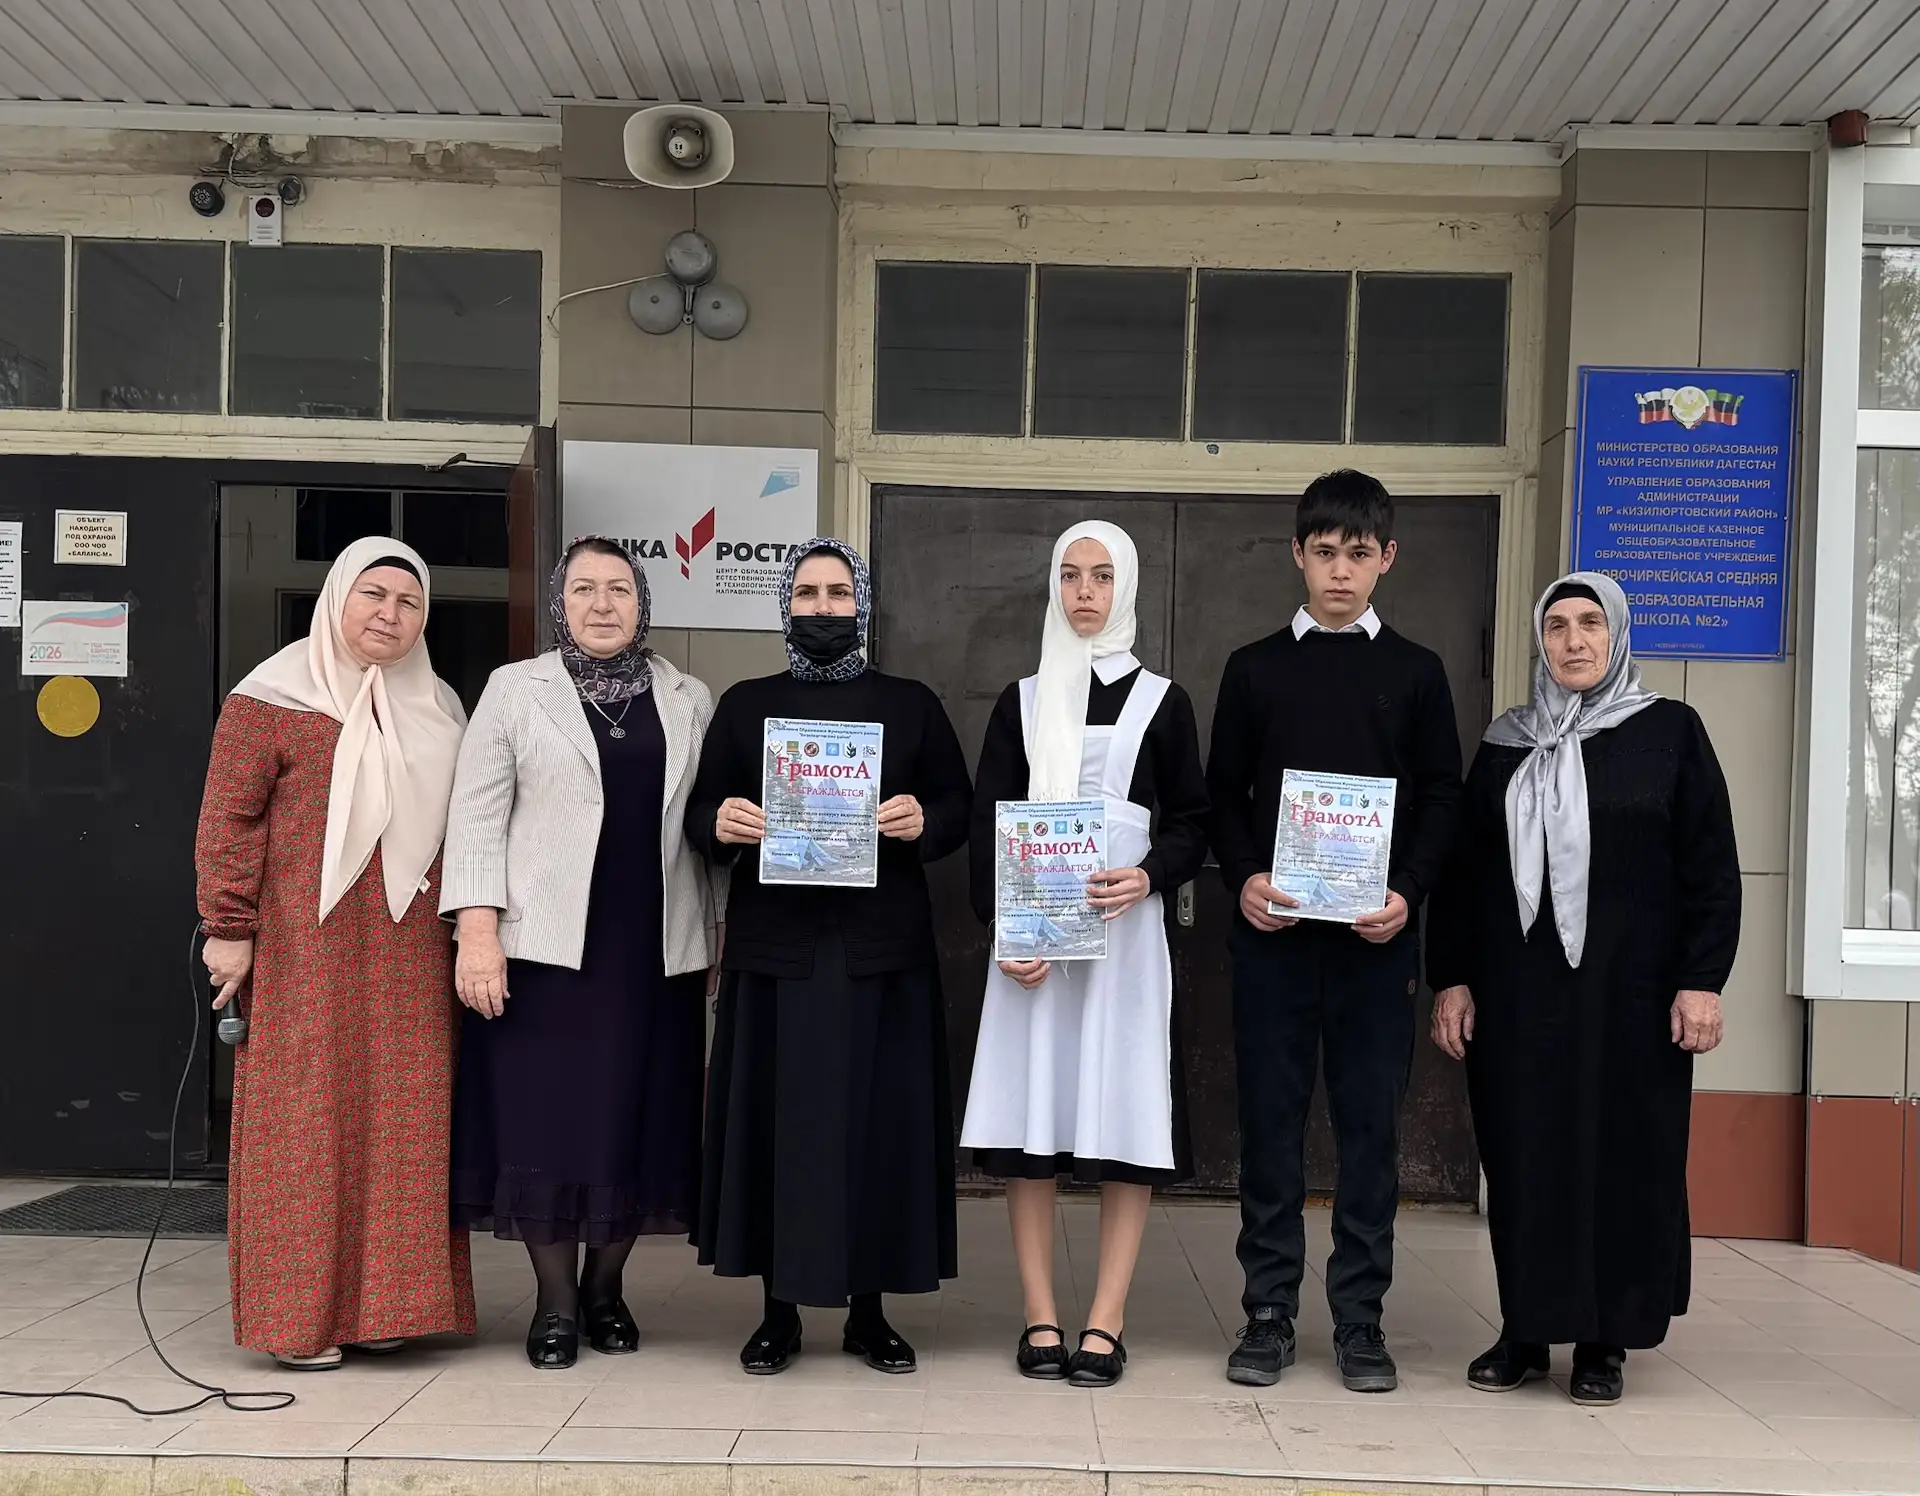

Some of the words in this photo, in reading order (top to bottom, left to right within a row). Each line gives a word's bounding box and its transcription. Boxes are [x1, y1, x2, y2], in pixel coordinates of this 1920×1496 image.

[1596, 442, 1690, 454] МИНИСТЕРСТВО
[1692, 443, 1779, 455] ОБРАЗОВАНИЯ
[1597, 457, 1635, 468] НАУКИ
[1637, 458, 1715, 469] РЕСПУБЛИКИ
[1716, 459, 1777, 470] ДАГЕСТАН
[1607, 476, 1683, 488] УПРАВЛЕНИЕ
[1685, 478, 1771, 489] ОБРАЗОВАНИЯ
[1637, 491, 1740, 504] АДМИНИСТРАЦИИ
[1596, 505, 1614, 516] МР
[1616, 505, 1732, 518] «КИЗИЛЮРТОВСКИЙ
[1733, 507, 1779, 519] РАЙОН»
[1608, 522, 1705, 534] МУНИЦИПАЛЬНОЕ
[1708, 524, 1765, 535] КАЗЕННОЕ
[1616, 536, 1756, 549] ОБЩЕОБРАЗОВАТЕЛЬНОЕ
[1594, 549, 1701, 561] ОБРАЗОВАТЕЛЬНОЕ
[1704, 551, 1777, 563] УЧРЕЖДЕНИЕ
[1592, 568, 1713, 584] ОВОЧИРКЕЙСКАЯ
[1716, 571, 1778, 586] СРЕДНЯЯ
[1627, 593, 1764, 608] ЕОБРАЗОВАТЕЛЬНАЯ
[1633, 613, 1690, 626] ШКОЛА
[1695, 614, 1728, 627] №2»
[29, 645, 62, 659] 2026
[787, 786, 864, 798] НАГРАЖДАЕТСЯ
[1020, 864, 1093, 873] НАГРАЖДАЕТСЯ
